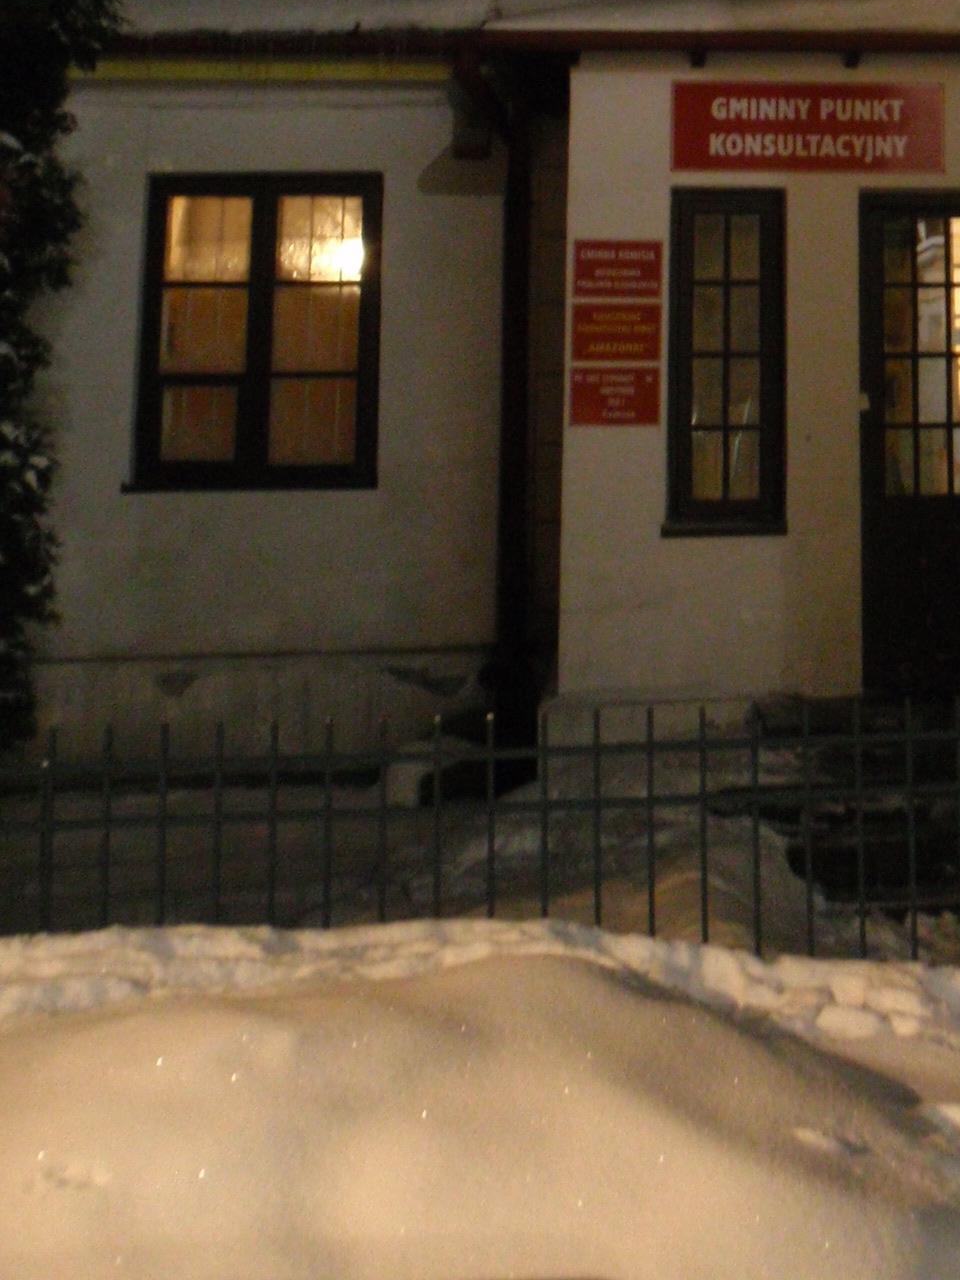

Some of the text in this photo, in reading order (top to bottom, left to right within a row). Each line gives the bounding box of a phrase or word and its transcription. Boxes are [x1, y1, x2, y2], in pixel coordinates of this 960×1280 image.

[711, 97, 904, 122] GMINNY PUNKT
[709, 133, 908, 164] KONSULTACYJNY
